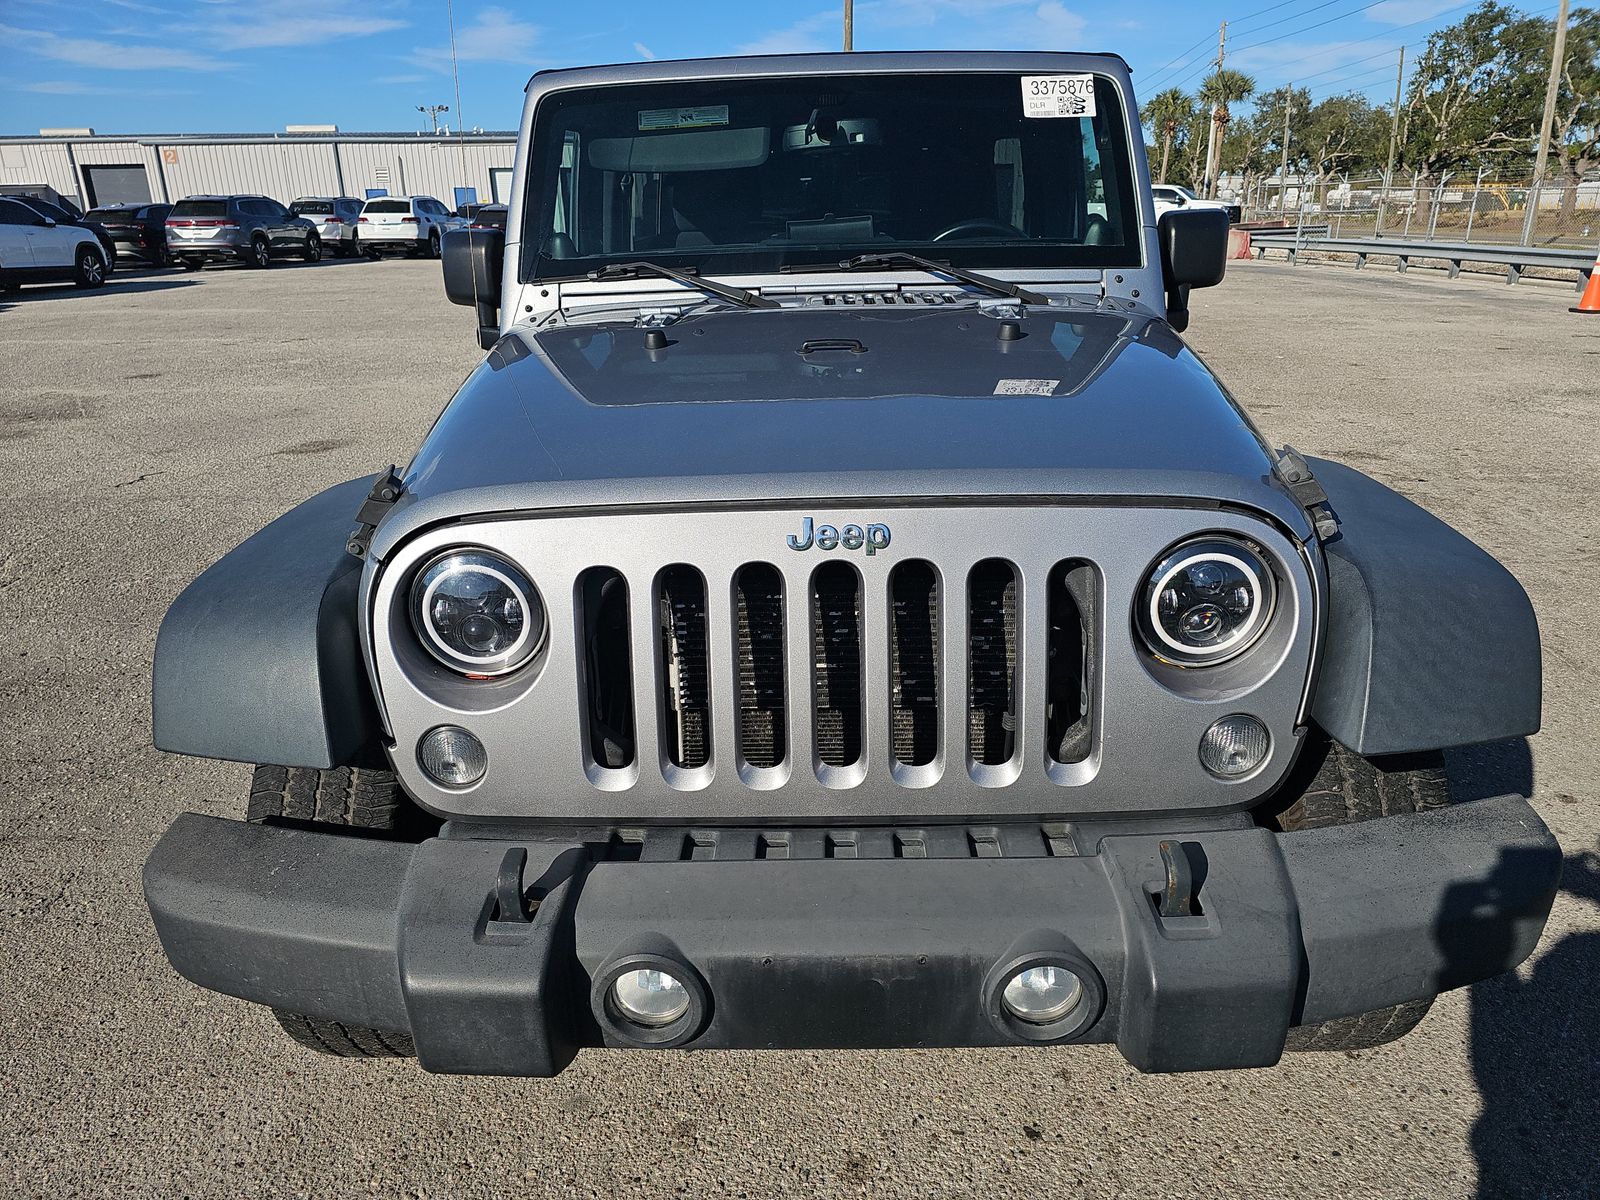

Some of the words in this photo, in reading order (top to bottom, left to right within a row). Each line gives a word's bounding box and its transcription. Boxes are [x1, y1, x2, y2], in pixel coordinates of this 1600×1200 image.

[1031, 79, 1094, 95] 3375876
[166, 150, 175, 162] 2
[783, 517, 891, 556] Jeep
